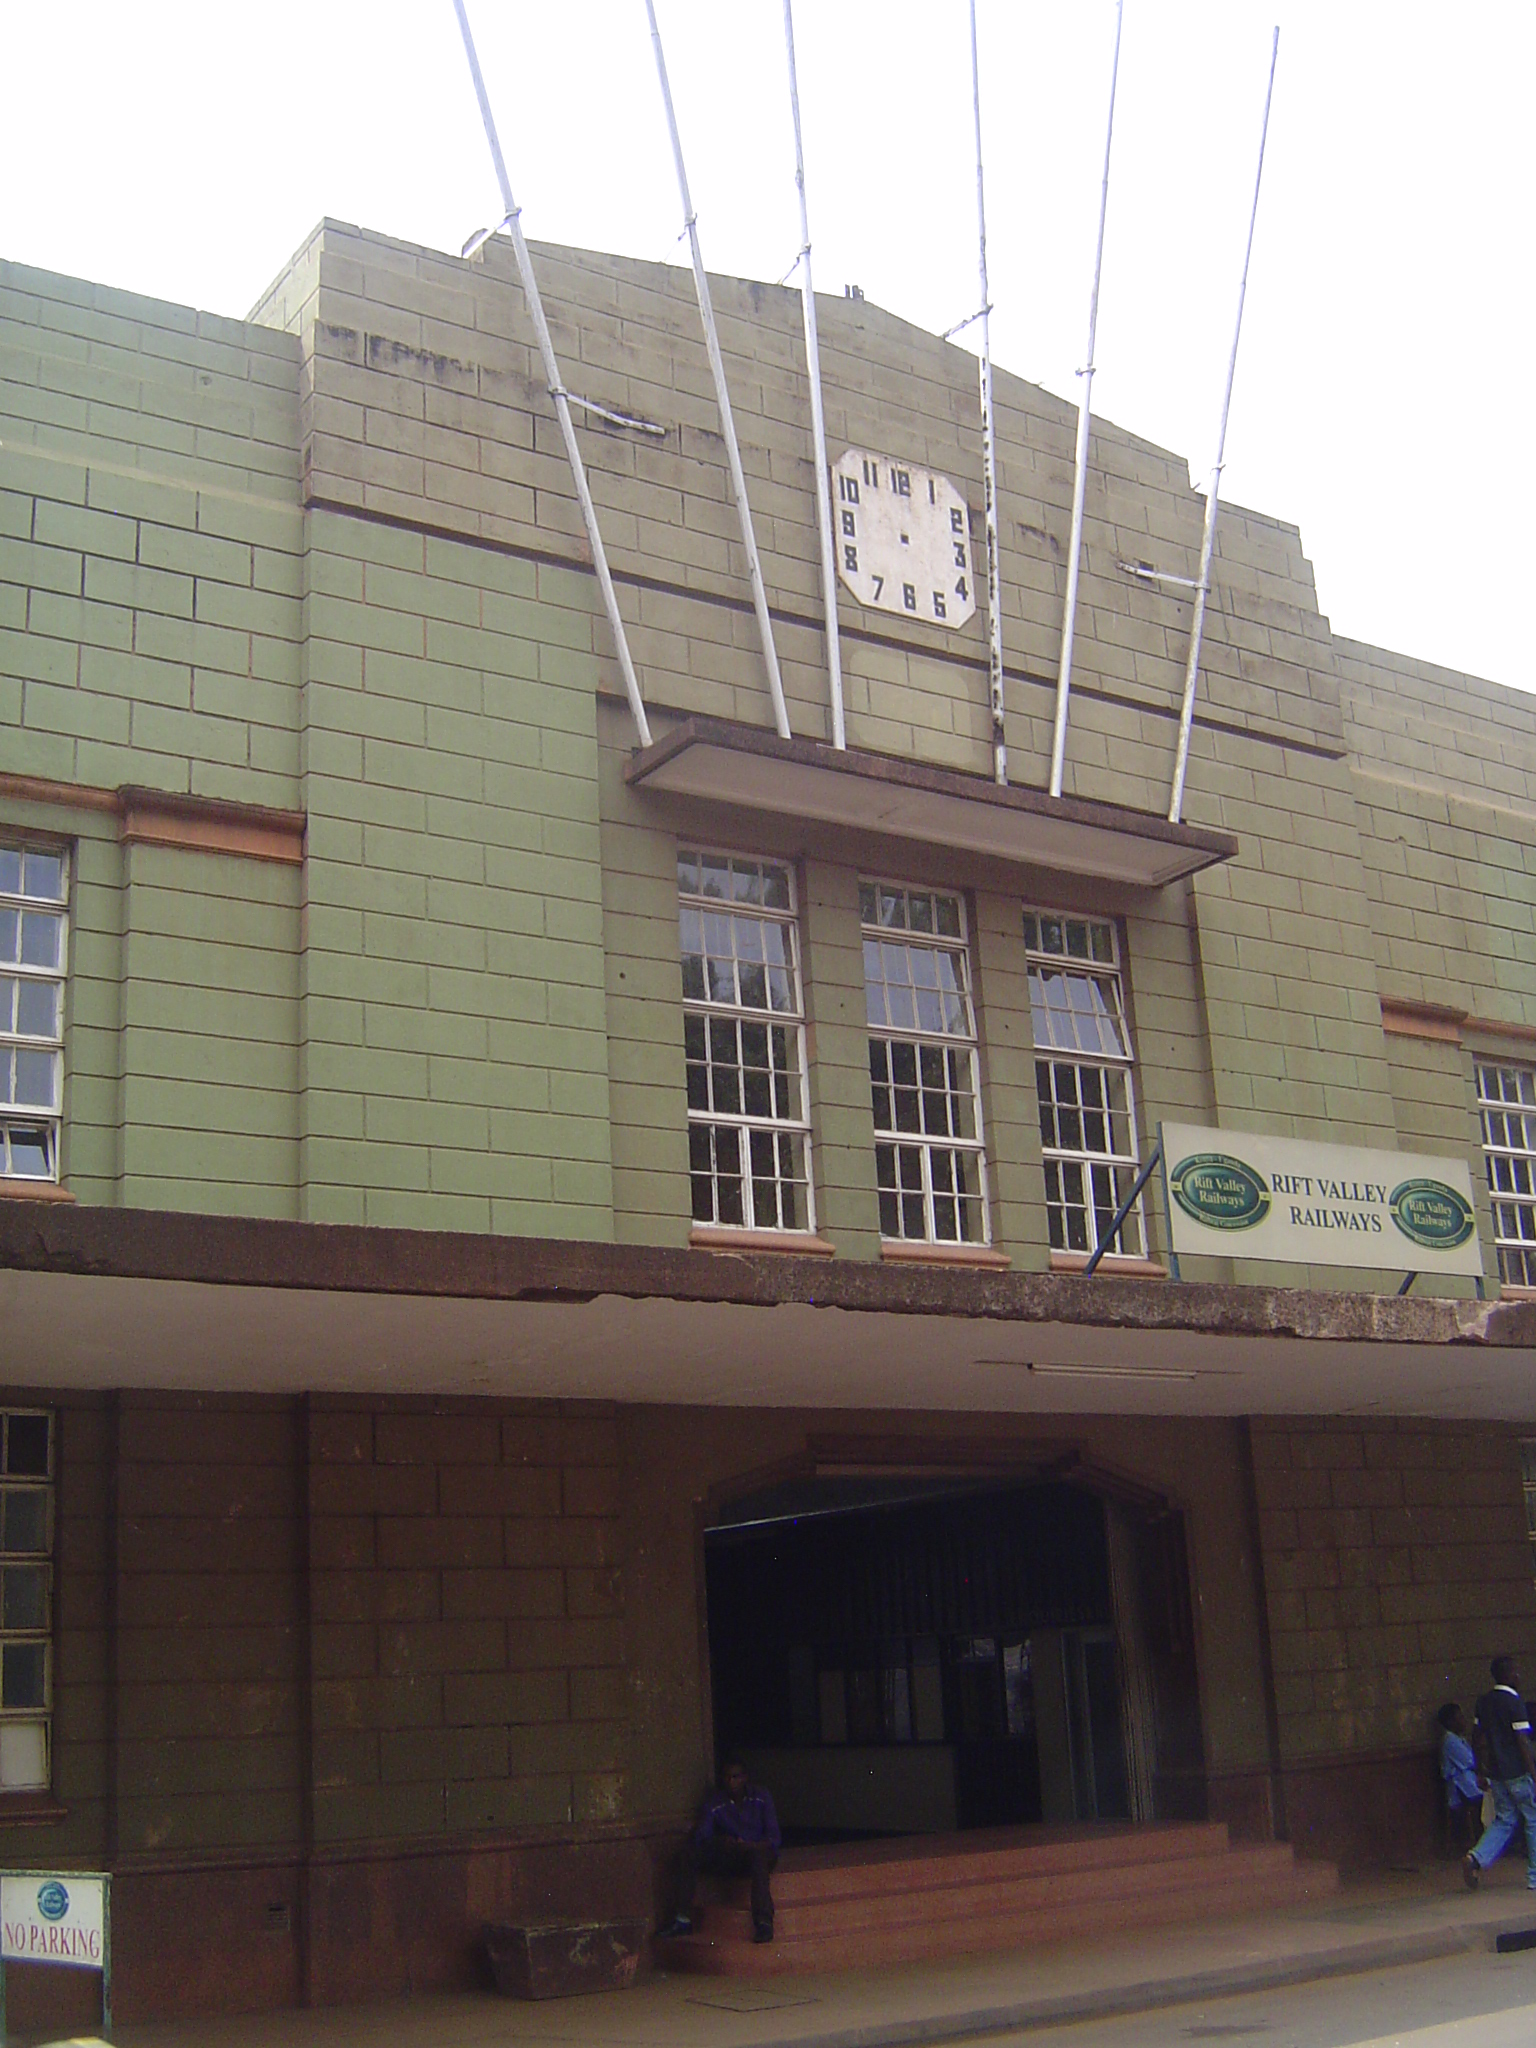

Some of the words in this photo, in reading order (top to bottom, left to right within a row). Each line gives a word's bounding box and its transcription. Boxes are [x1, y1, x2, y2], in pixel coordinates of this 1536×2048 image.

[862, 460, 878, 488] 11
[890, 468, 911, 497] 12
[839, 474, 860, 504] 10
[928, 479, 936, 505] 1
[841, 509, 855, 537] 9
[949, 507, 963, 534] 2
[844, 544, 858, 572] 8
[953, 541, 966, 568] 3
[871, 574, 884, 601] 7
[902, 582, 916, 611] 6
[955, 575, 969, 601] 4
[933, 591, 947, 618] 5
[1194, 1176, 1213, 1190] Rift
[1215, 1177, 1246, 1194] Valley
[1271, 1173, 1313, 1196] RIFT
[1316, 1178, 1387, 1203] VALLEY
[1199, 1190, 1245, 1208] Railways
[1409, 1199, 1426, 1212] Rift
[1427, 1201, 1452, 1217] Valley
[1289, 1205, 1382, 1233] RAILWAYS
[1413, 1212, 1452, 1230] Railways
[5, 1922, 26, 1951] NO
[30, 1924, 100, 1959] PARKING
